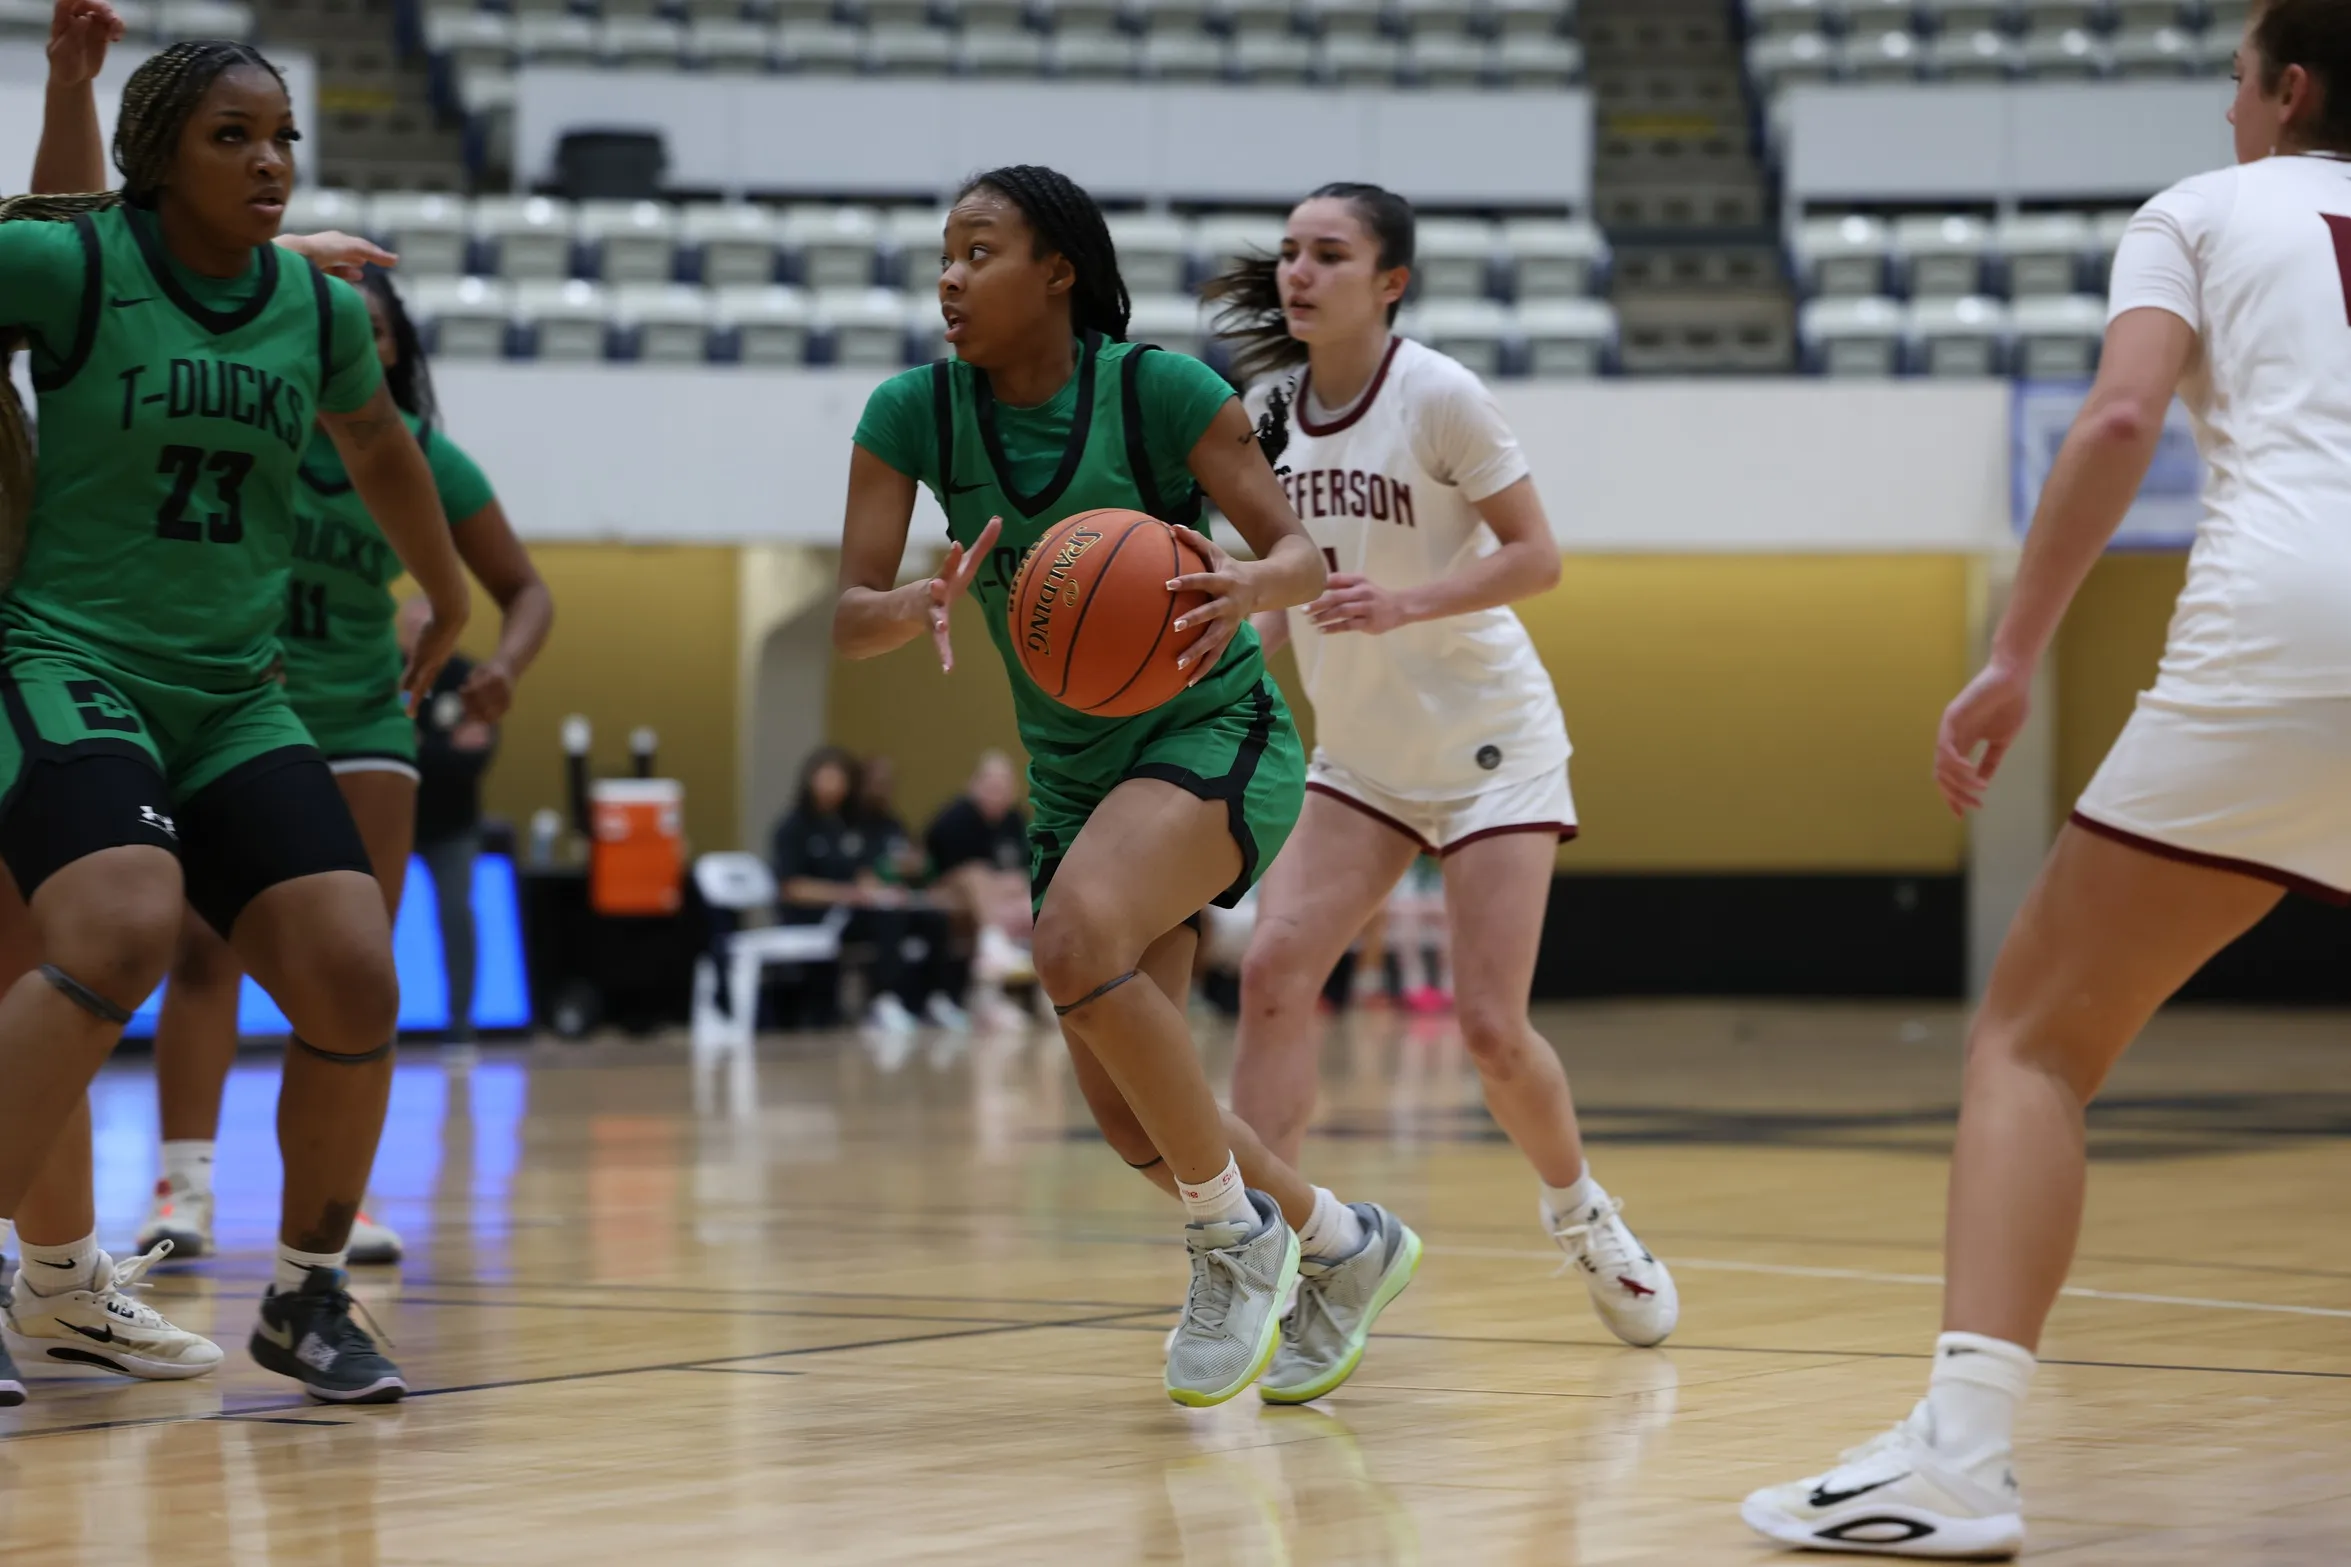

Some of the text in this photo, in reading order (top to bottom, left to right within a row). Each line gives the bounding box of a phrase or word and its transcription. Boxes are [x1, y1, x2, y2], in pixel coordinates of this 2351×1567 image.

[118, 357, 305, 453] T-DUCKS
[156, 444, 256, 545] 23
[1283, 468, 1416, 528] FFERSON
[1027, 526, 1104, 656] SPALDING
